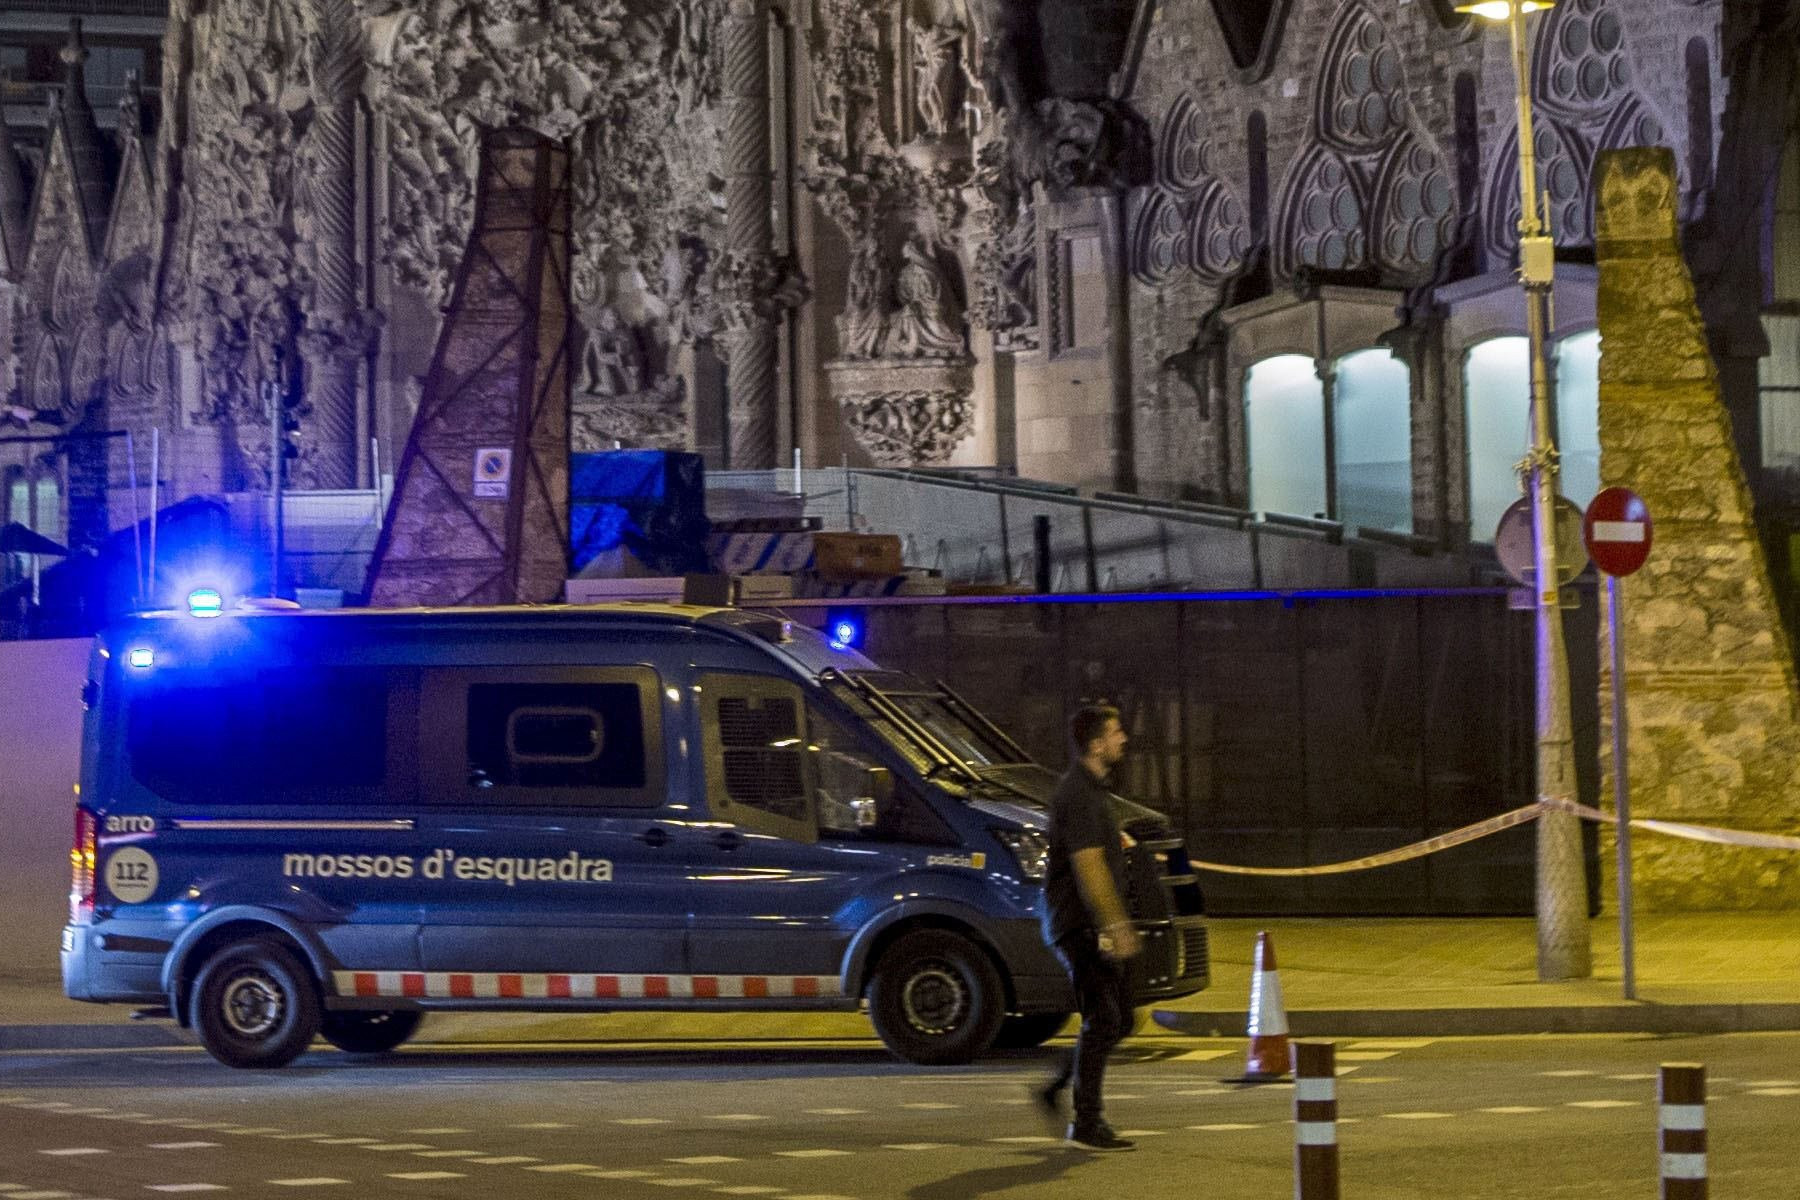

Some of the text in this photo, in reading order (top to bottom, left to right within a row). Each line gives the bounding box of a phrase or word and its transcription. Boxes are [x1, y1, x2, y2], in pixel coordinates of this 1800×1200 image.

[116, 862, 149, 881] 112
[283, 848, 613, 886] mossos d'esquadra
